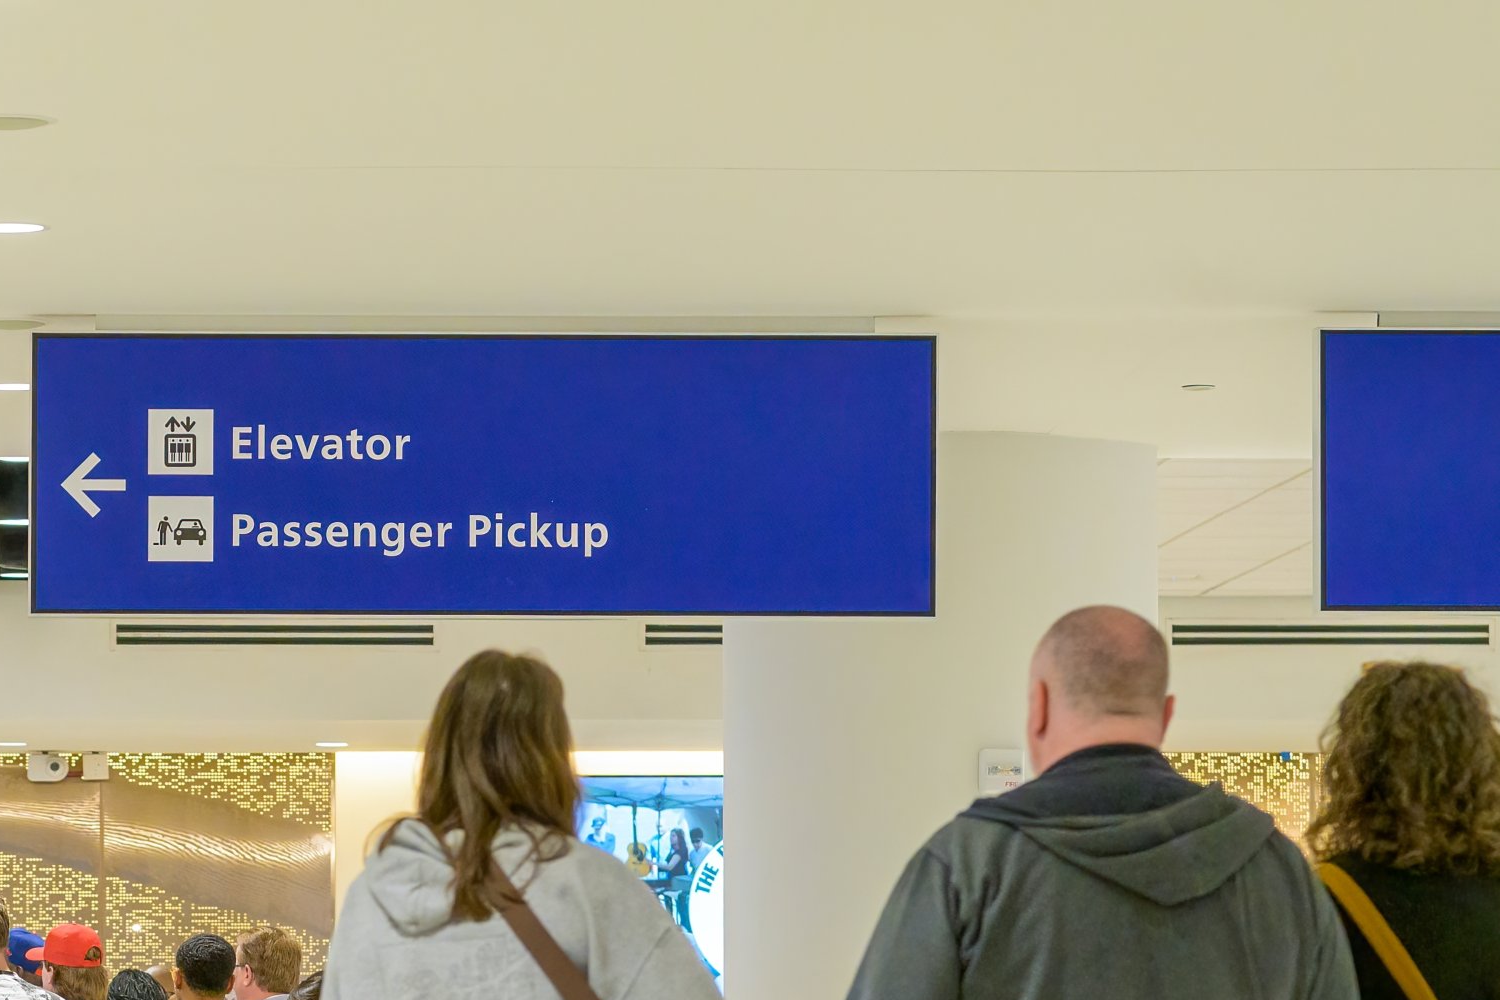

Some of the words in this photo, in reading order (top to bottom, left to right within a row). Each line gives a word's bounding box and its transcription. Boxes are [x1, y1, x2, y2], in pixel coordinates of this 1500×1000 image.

[233, 425, 410, 460] Elevator
[233, 514, 452, 556] Passenger
[469, 513, 608, 557] Pickup
[695, 863, 719, 893] THE
